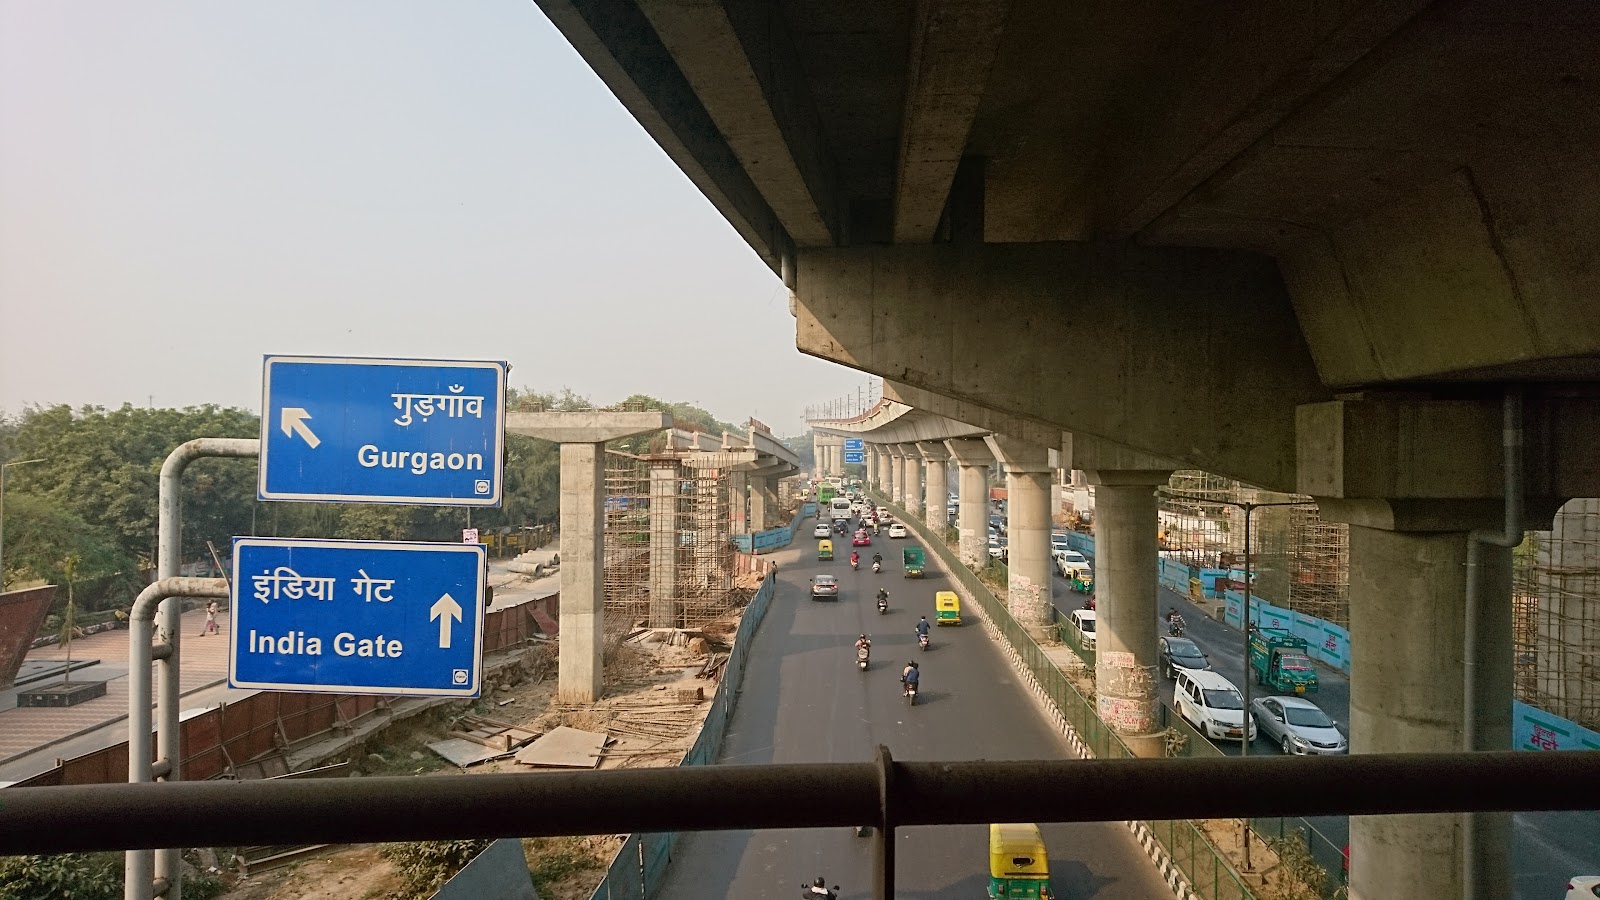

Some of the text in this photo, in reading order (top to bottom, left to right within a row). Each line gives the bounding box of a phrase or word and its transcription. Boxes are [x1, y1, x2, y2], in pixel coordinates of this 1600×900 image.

[391, 384, 484, 426] गुड़गाँव
[358, 444, 483, 475] Gurgaon
[252, 567, 395, 603] इंडिया गेट
[250, 630, 403, 658] India Gate
